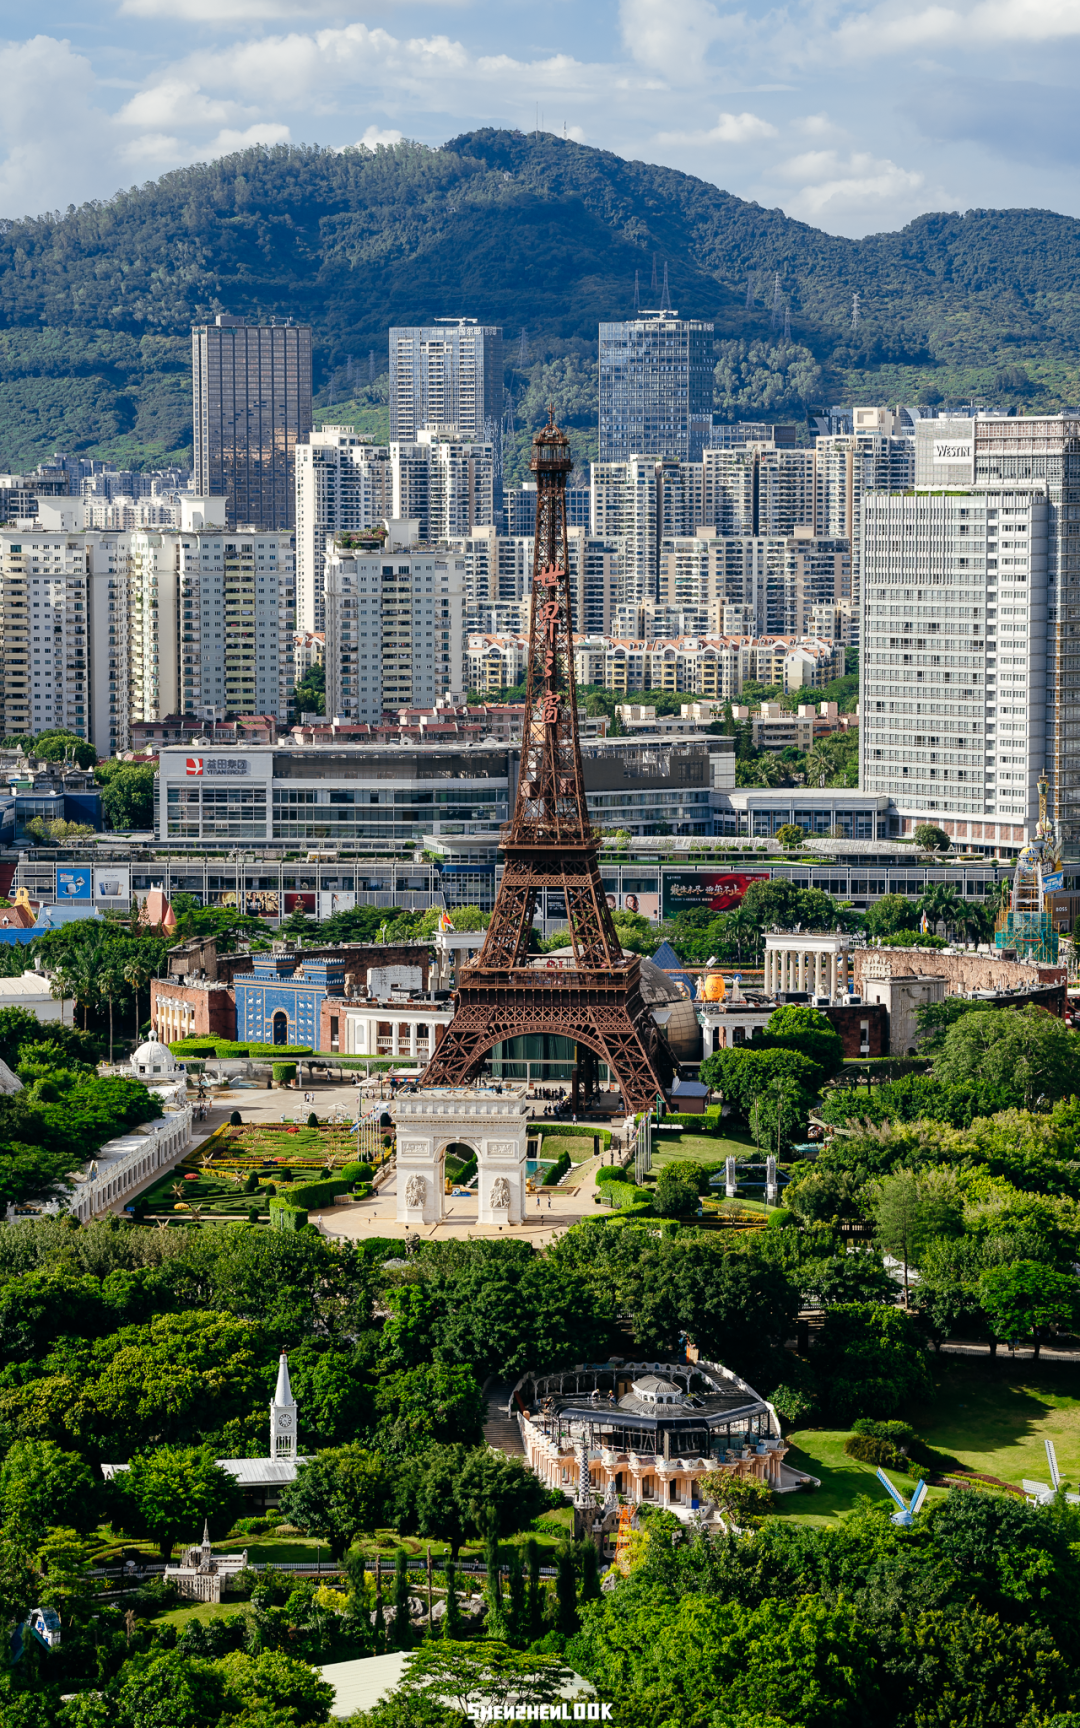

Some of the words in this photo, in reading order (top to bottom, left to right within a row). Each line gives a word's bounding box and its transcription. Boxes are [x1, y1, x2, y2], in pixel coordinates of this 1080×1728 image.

[936, 445, 970, 457] WESTIN
[534, 563, 566, 724] 世界之窗
[207, 759, 247, 769] 益田集团
